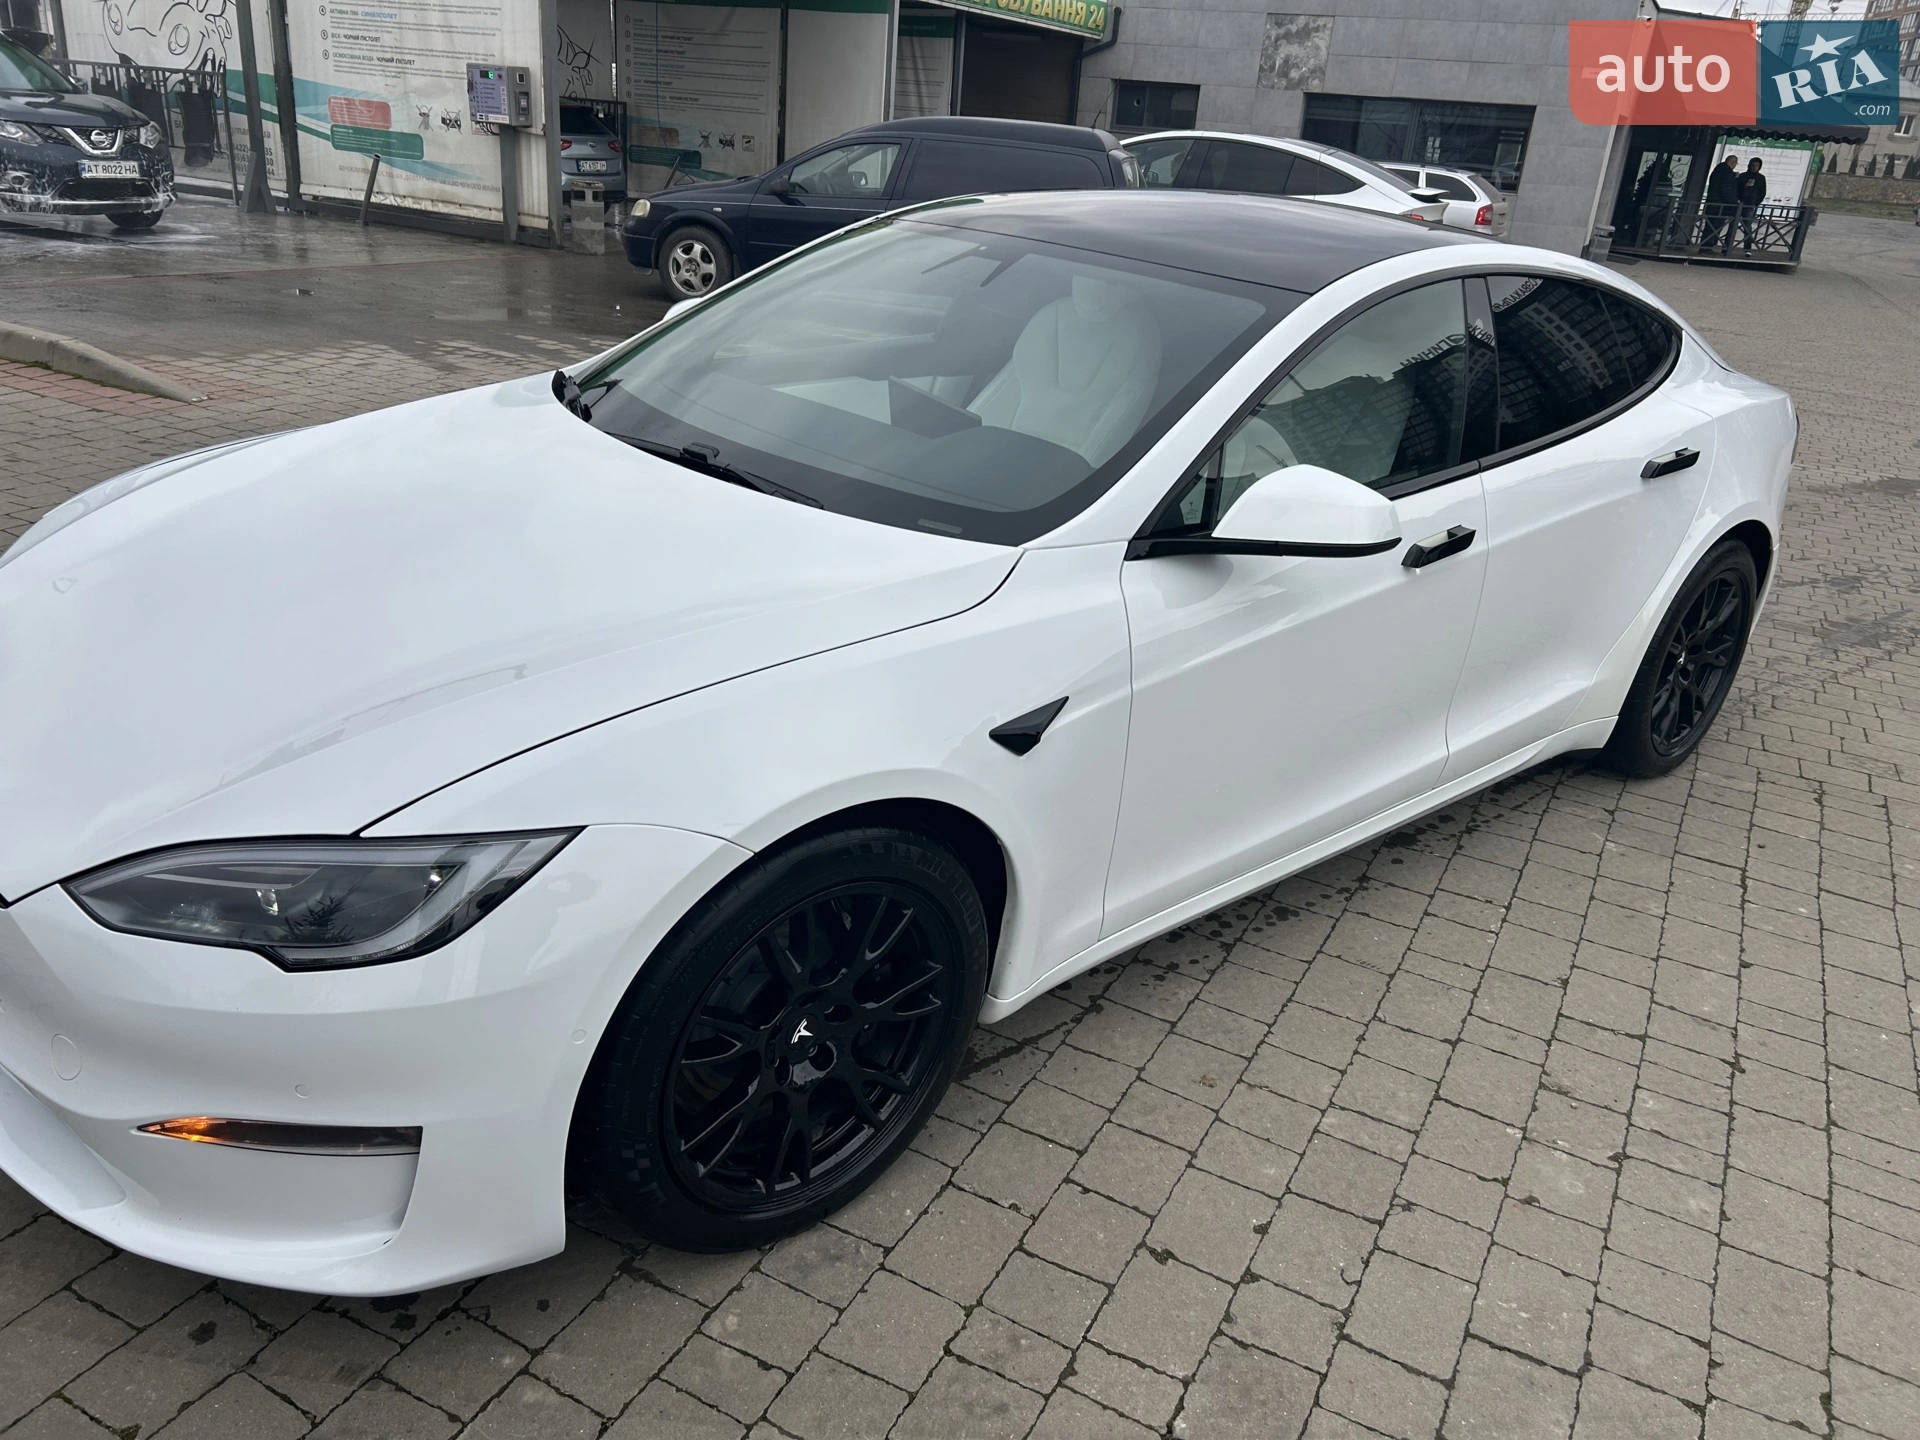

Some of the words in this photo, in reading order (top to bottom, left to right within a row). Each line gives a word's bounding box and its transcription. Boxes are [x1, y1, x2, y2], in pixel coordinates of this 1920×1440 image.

[1088, 4, 1105, 30] 24
[87, 164, 100, 174] AT
[101, 164, 123, 175] 8022
[124, 164, 138, 174] HA
